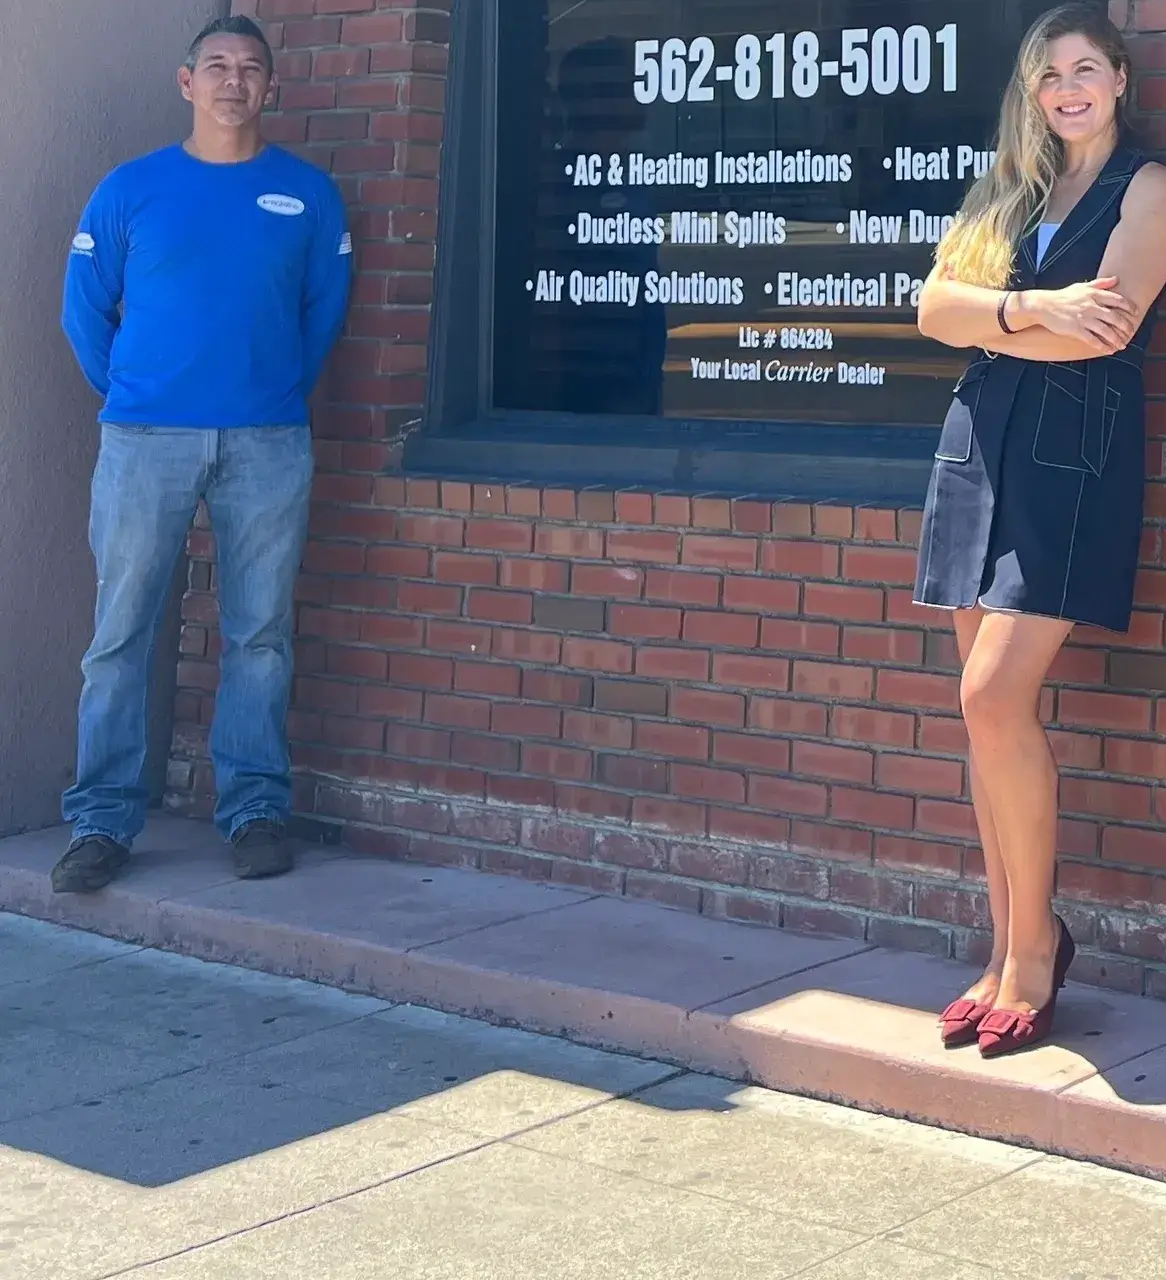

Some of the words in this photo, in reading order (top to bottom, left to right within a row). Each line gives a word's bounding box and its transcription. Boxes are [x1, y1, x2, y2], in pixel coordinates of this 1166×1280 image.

[633, 23, 958, 104] 562-818-5001
[607, 153, 624, 186] &
[629, 152, 709, 188] Heating
[715, 149, 852, 184] Installations
[895, 146, 950, 181] Heat
[577, 212, 665, 244] Ductless
[670, 211, 718, 244] Mini
[724, 211, 786, 249] Splits
[849, 210, 903, 244] New
[909, 209, 960, 244] Duc
[535, 270, 564, 302] Air
[569, 270, 640, 307] Quality
[644, 270, 744, 305] Solutions
[777, 272, 887, 308] Electrical
[894, 273, 925, 308] Pa
[738, 326, 760, 348] Lic
[762, 328, 777, 349] #
[780, 327, 834, 350] 864284
[690, 357, 721, 379] Your
[724, 358, 761, 381] Local
[764, 359, 834, 383] Carrier
[837, 362, 886, 385] Dealer
